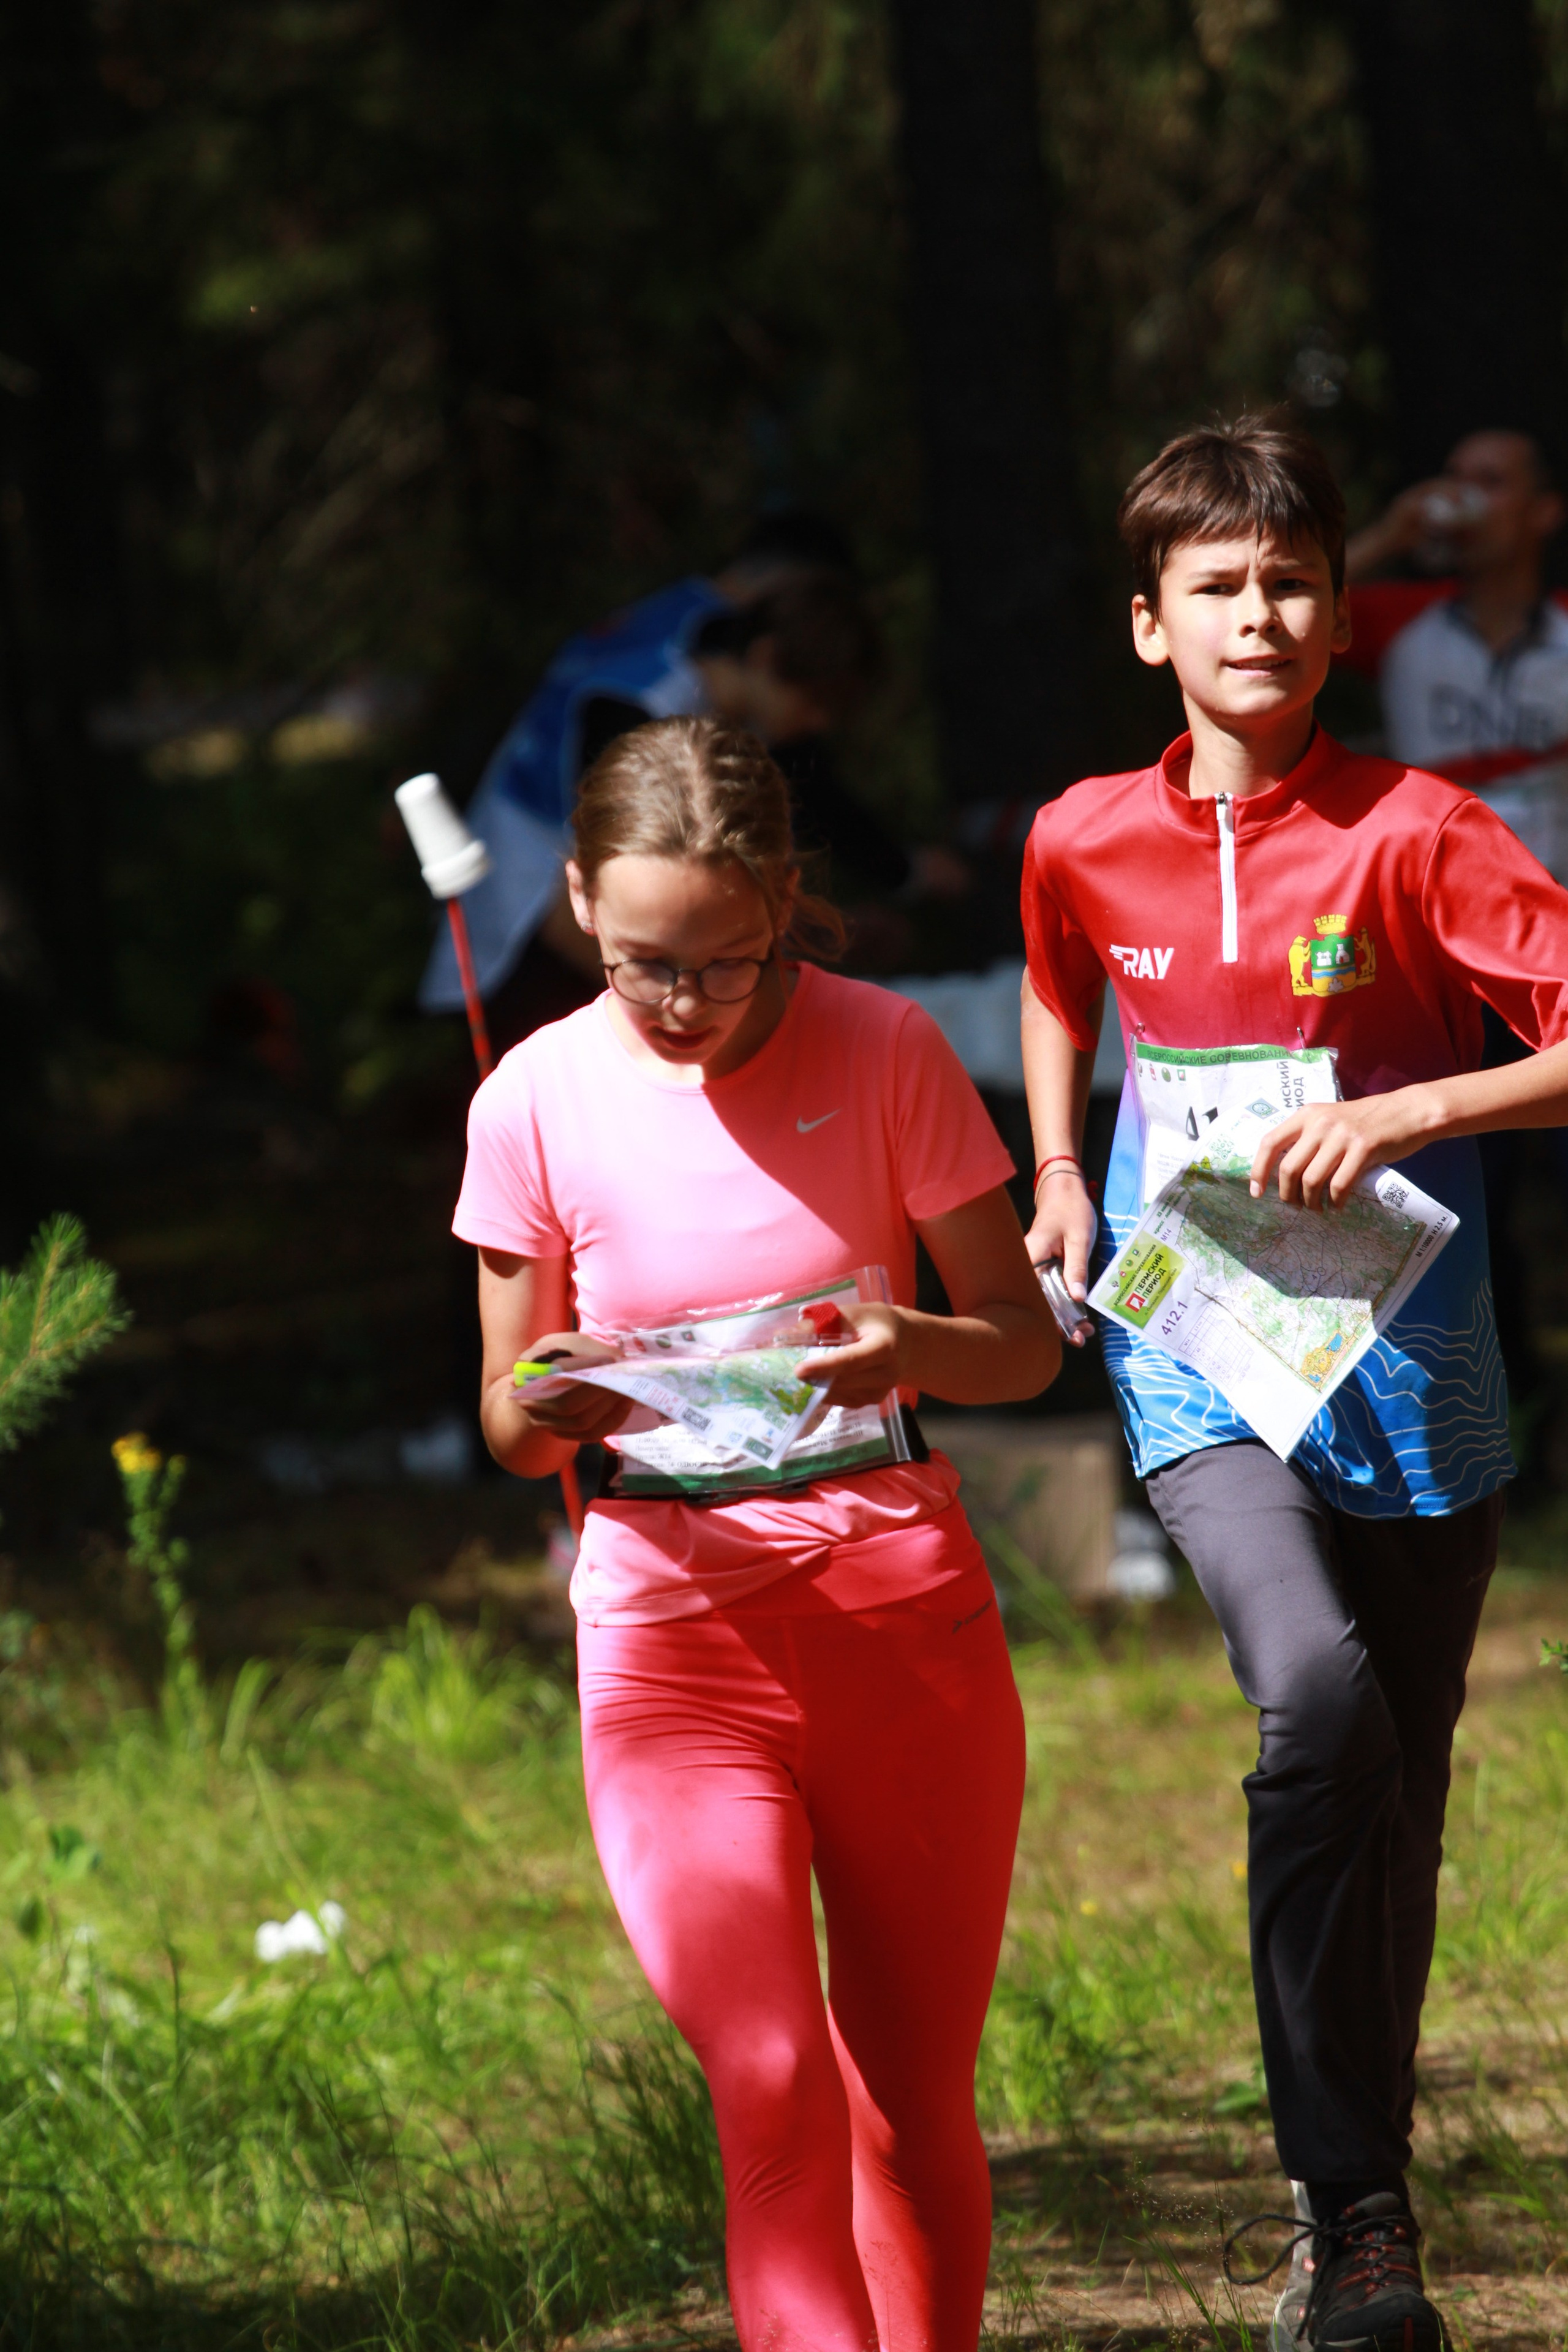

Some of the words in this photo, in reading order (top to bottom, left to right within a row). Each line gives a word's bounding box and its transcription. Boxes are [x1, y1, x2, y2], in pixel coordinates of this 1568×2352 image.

[1109, 944, 1174, 980] RAY
[1147, 1050, 1207, 1064] ВСЕРОССИЙСКИЕ
[1210, 1050, 1290, 1063] СОРЕВНОВАНИ
[1276, 1061, 1292, 1108] МСКИЙ
[1293, 1077, 1305, 1110] ИОД
[1114, 1273, 1137, 1306] ВСЕРОССИЙСКИЕ
[1136, 1244, 1156, 1275] СОРЕВНОВАНИЯ
[1134, 1253, 1164, 1293] ПЕРМСКИЙ
[1142, 1267, 1167, 1298] ПЕРИОД
[1161, 1300, 1188, 1335] 412.1
